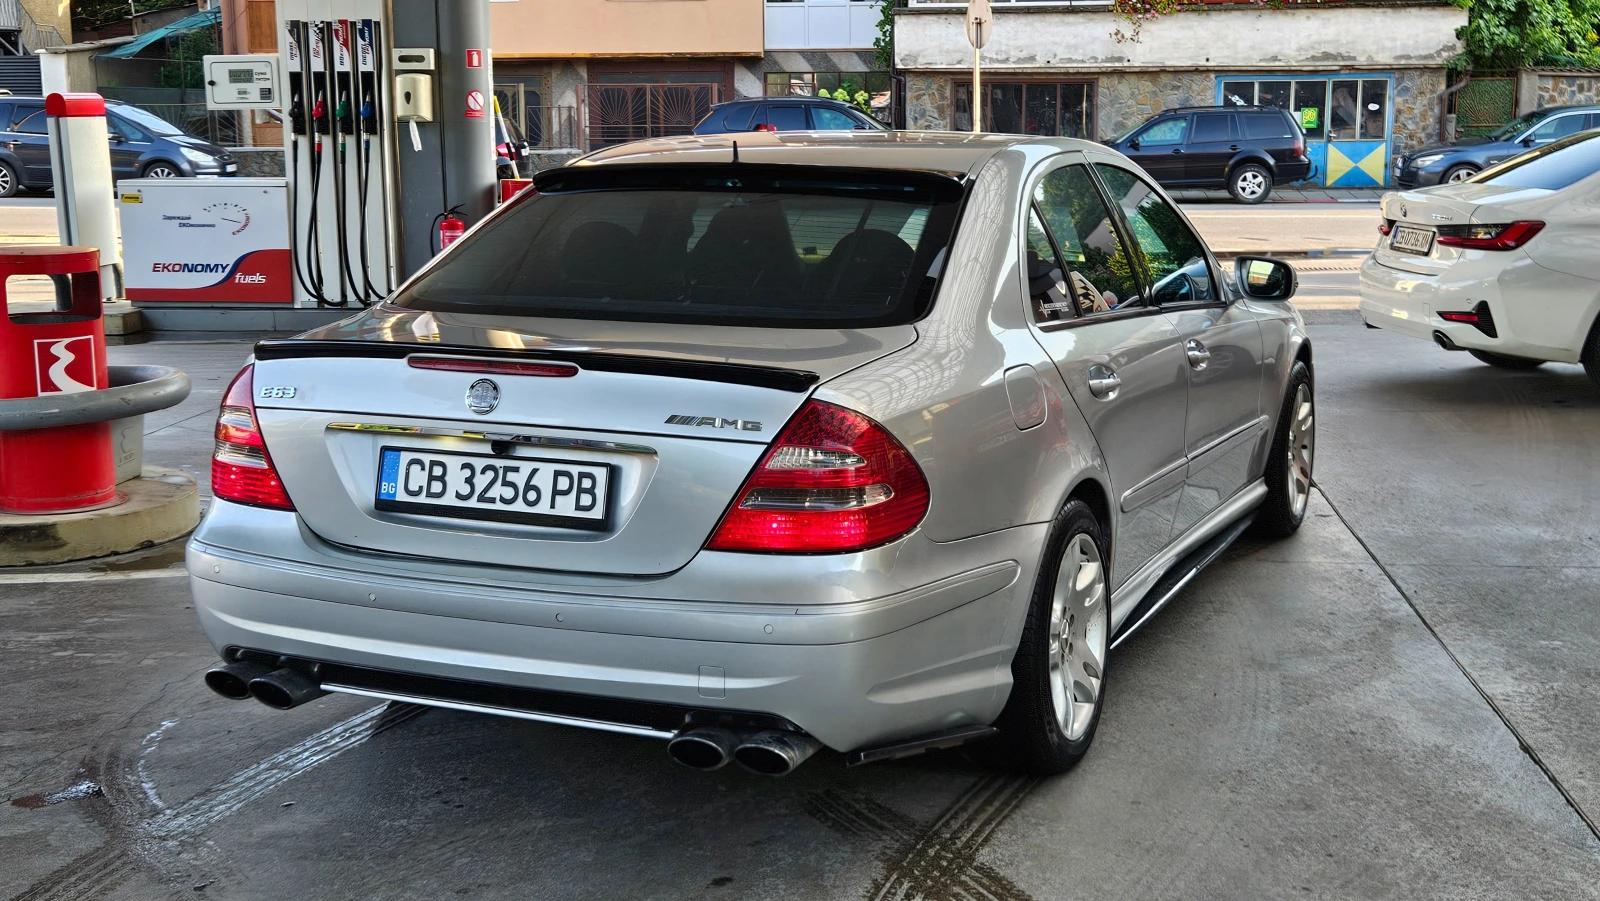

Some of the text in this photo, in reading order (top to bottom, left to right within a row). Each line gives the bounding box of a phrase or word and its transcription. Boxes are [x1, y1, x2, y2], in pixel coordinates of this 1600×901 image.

[152, 262, 230, 274] EKONOMY
[234, 272, 267, 284] fuels
[259, 386, 296, 398] E63
[381, 481, 396, 494] BG
[403, 458, 597, 511] CB 3256 PB
